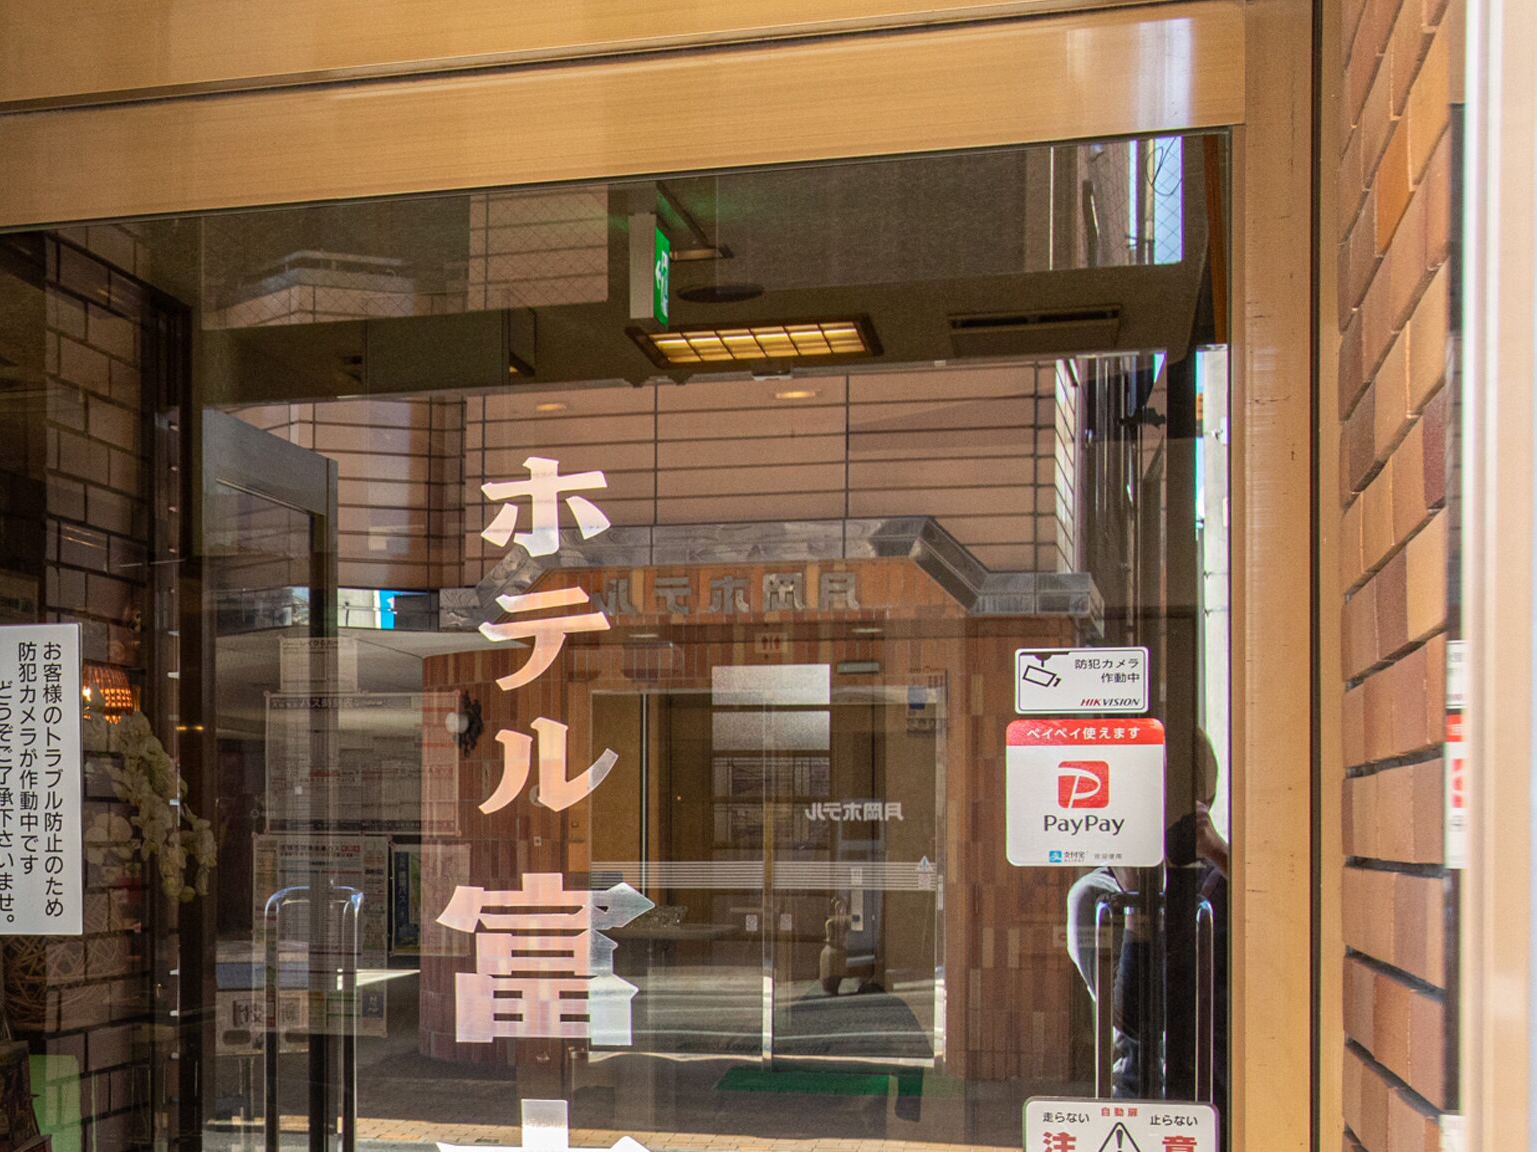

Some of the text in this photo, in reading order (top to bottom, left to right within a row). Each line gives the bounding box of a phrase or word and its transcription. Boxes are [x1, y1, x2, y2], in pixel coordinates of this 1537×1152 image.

[1074, 658, 1140, 669] 防犯カメラ
[1100, 672, 1140, 684] 作動中
[1080, 697, 1140, 707] HIKVISION
[1026, 726, 1141, 740] ペイペイ使えます
[18, 641, 39, 875] 防犯カメラが作動中です
[43, 641, 64, 918] お客様のトラブル防止のため
[1043, 814, 1125, 836] PayPay
[1042, 1111, 1090, 1124] 走らない
[1149, 1114, 1199, 1127] 止らない
